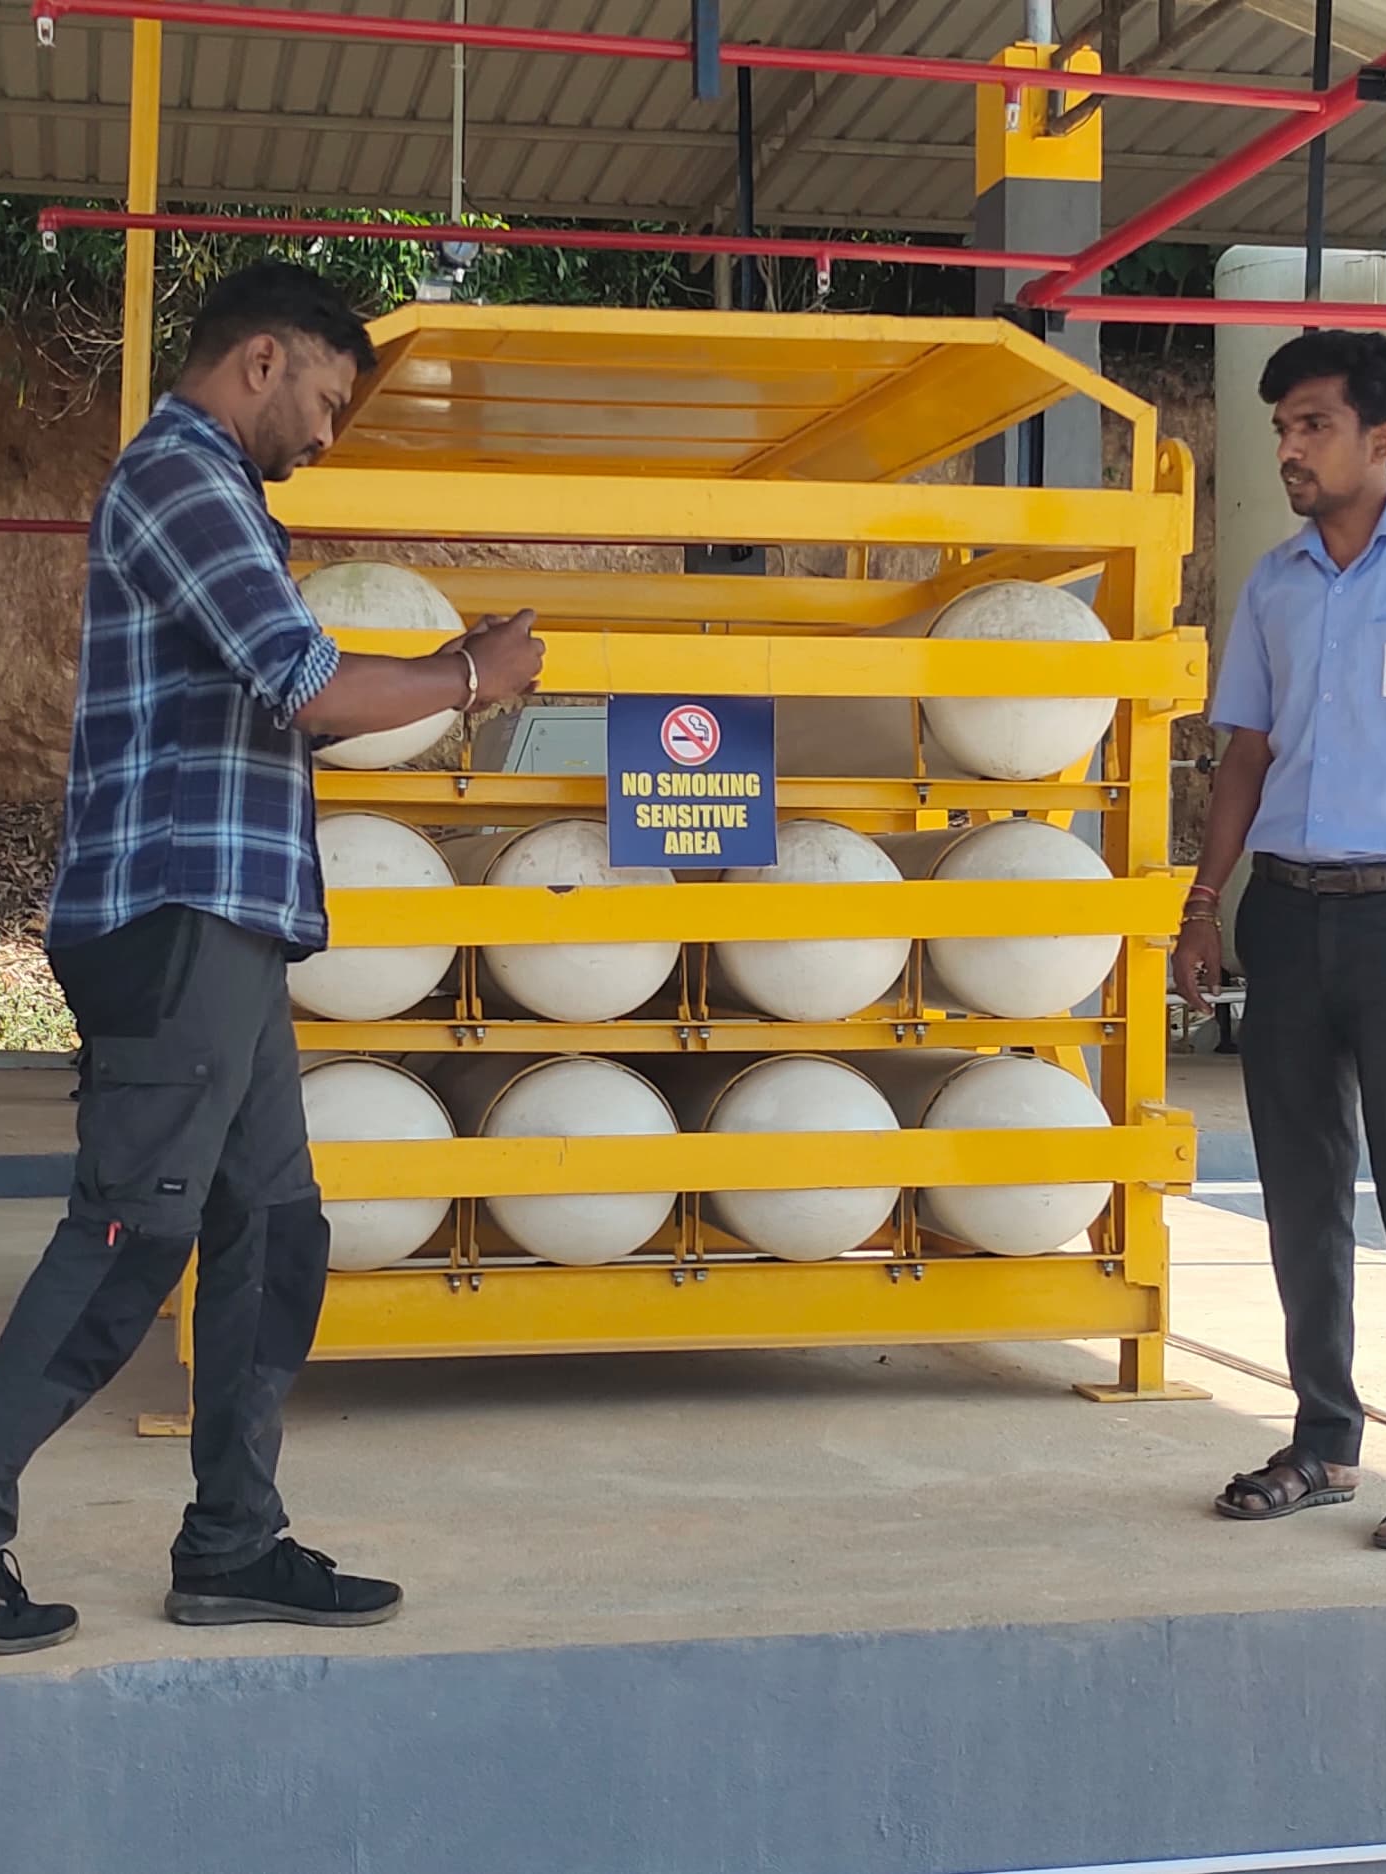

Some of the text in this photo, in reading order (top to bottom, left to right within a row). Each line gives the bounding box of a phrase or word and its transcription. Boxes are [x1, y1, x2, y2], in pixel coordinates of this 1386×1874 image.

[621, 772, 761, 797] NO SMOKING
[635, 803, 749, 828] SENSITIVE
[663, 831, 722, 855] AREA
